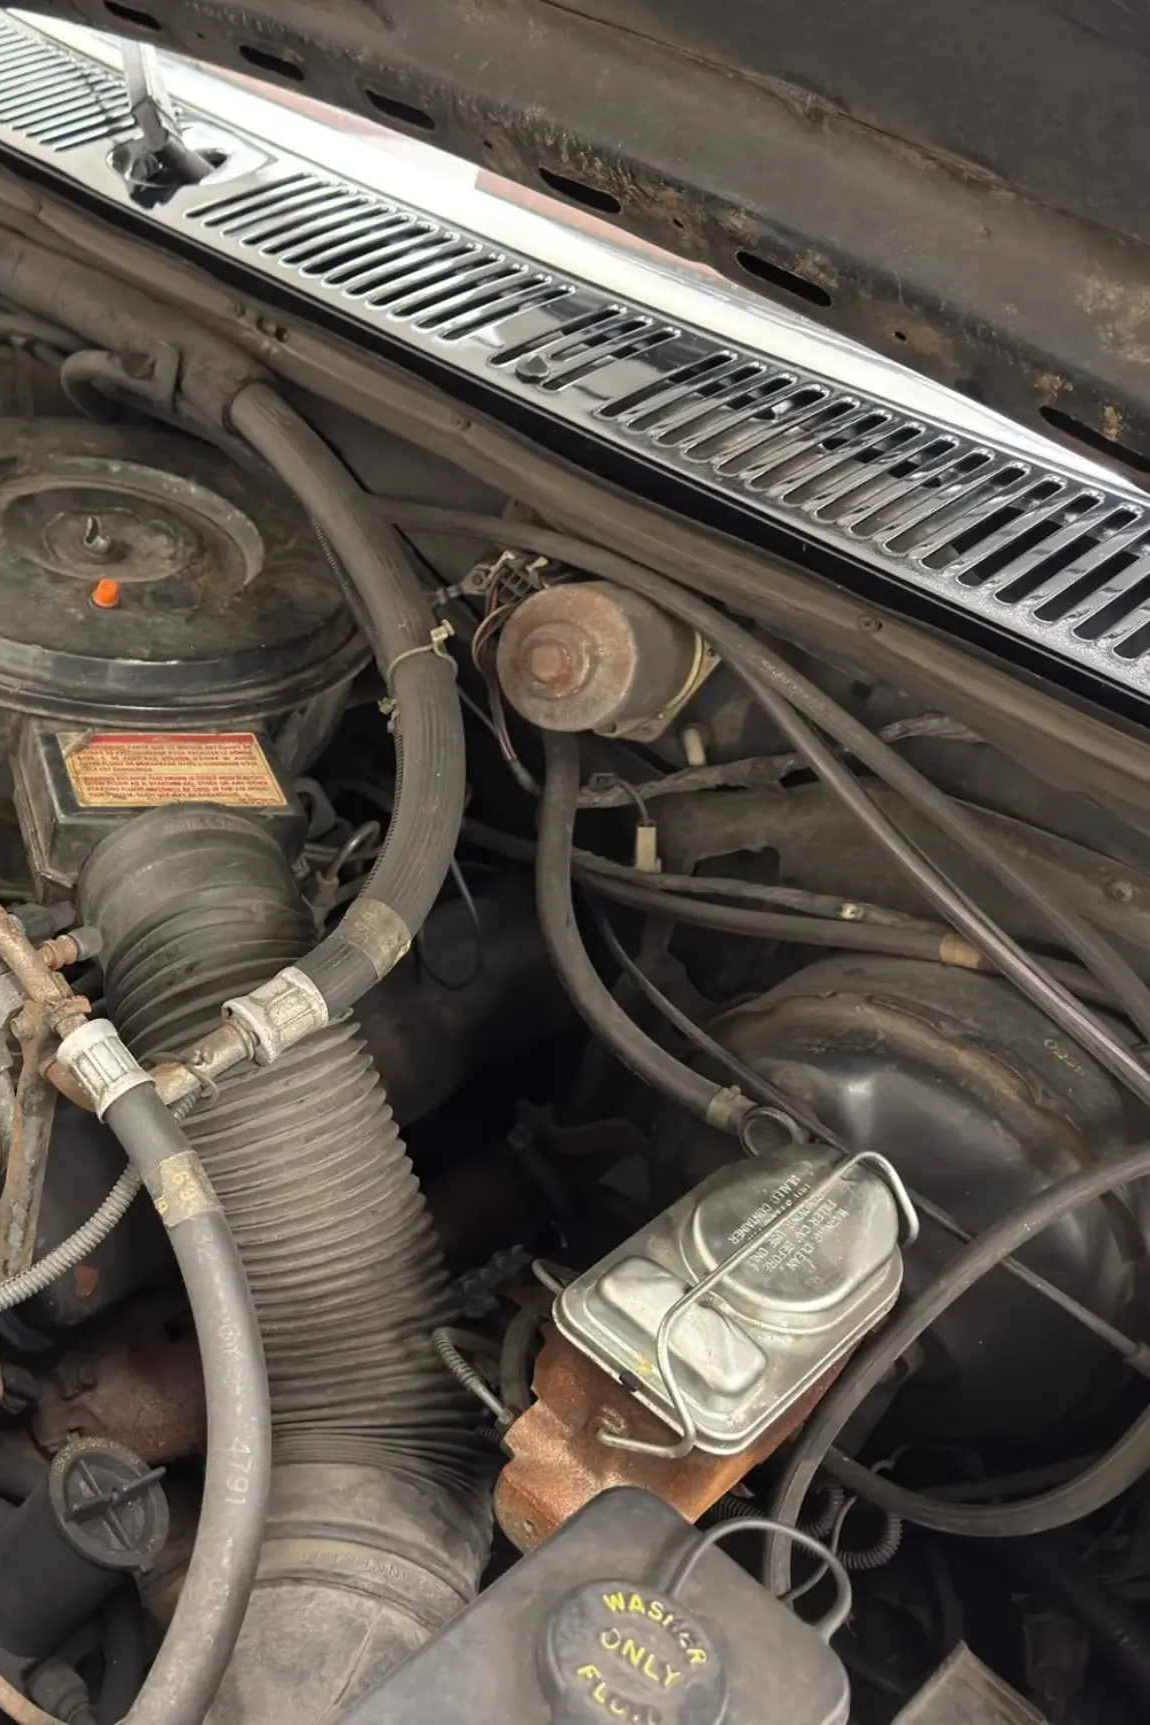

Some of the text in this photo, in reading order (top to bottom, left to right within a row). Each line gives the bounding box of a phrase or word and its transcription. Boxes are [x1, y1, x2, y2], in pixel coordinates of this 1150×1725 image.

[727, 1202, 772, 1245] CONTAINER
[224, 1437, 251, 1505] 4791
[601, 1627, 682, 1687] ONLY
